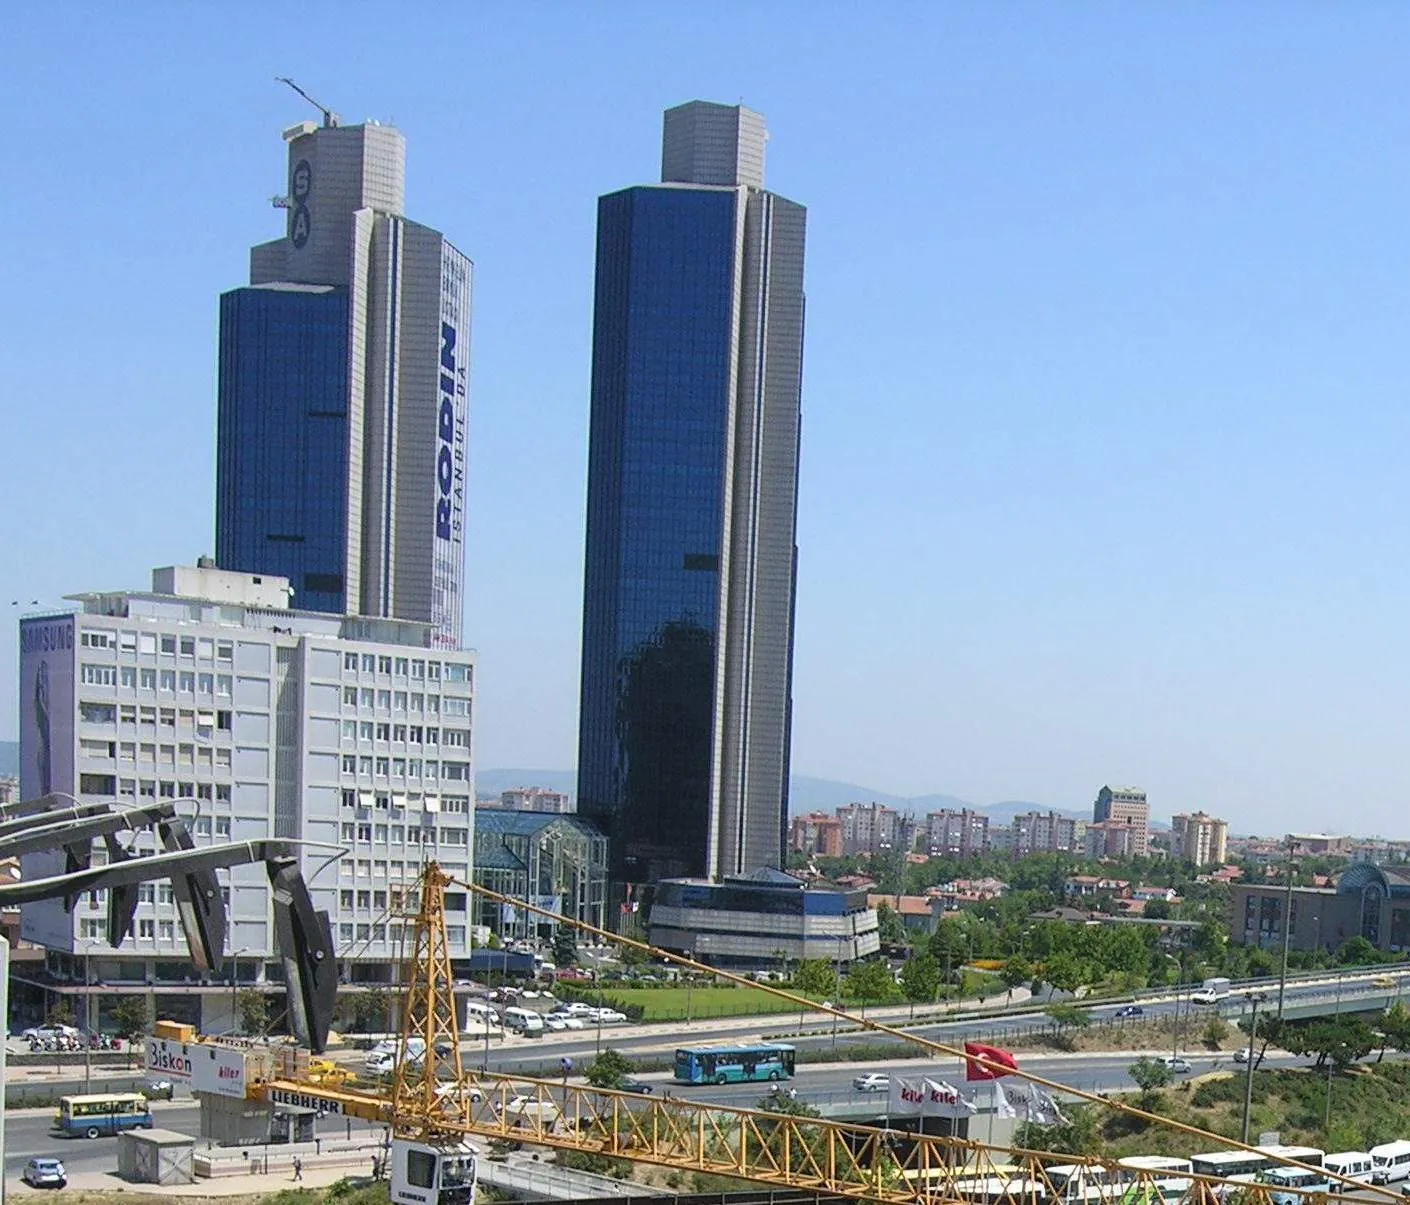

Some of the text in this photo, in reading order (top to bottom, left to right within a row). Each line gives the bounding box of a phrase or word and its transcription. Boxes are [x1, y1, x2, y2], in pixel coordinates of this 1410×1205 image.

[436, 321, 456, 541] RODIN
[22, 624, 73, 653] SAMSUNG
[272, 1090, 339, 1114] LIEBHERR
